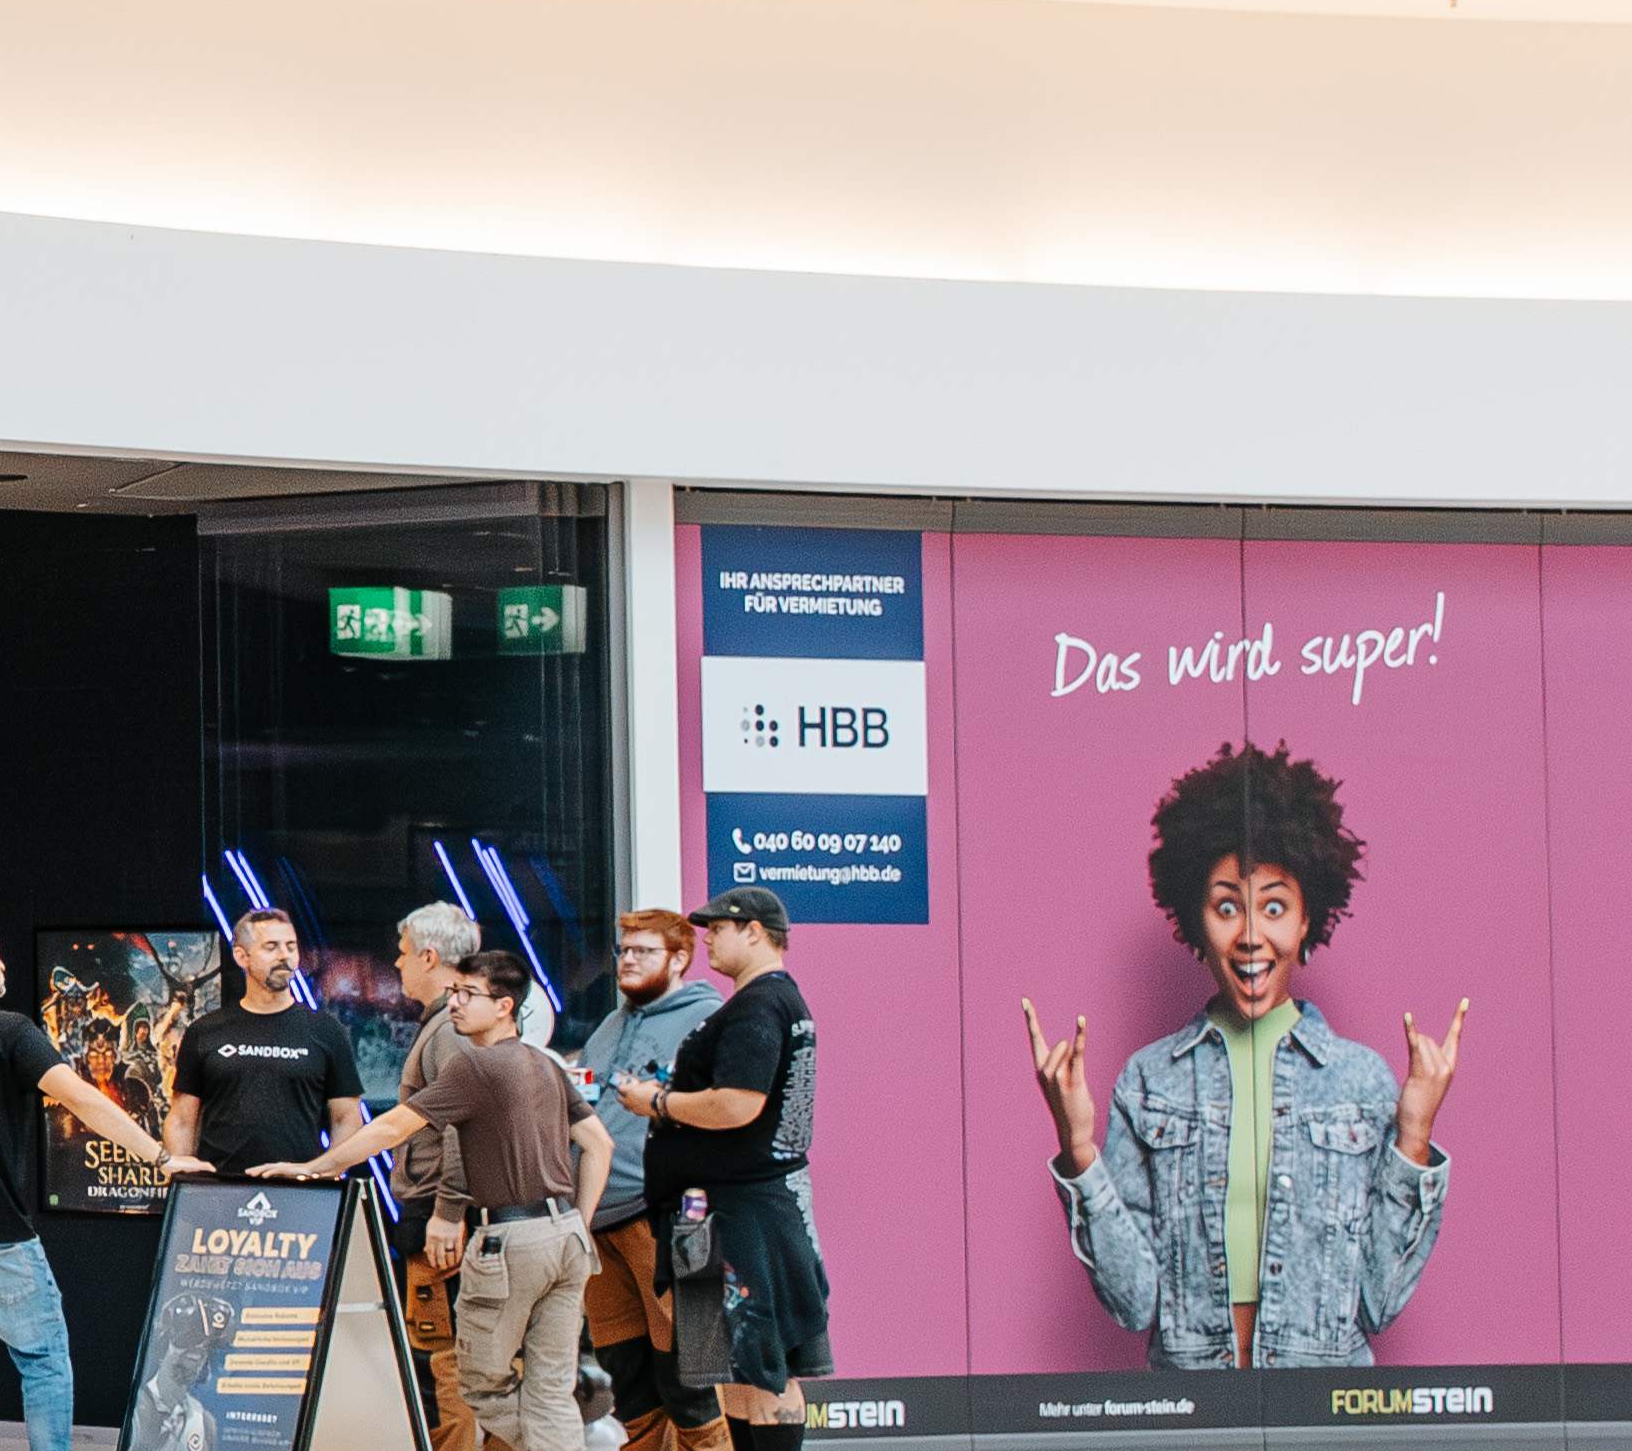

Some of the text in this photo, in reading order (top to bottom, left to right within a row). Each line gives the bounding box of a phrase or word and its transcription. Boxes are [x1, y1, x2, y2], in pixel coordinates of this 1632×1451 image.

[720, 572, 905, 594] IHR ANSPRECHPARTNER
[744, 592, 883, 616] FÜR VERMIETUNG
[1051, 592, 1445, 706] Das wird super!
[798, 706, 889, 748] HBB
[754, 830, 902, 855] 040 60 09 07 140
[759, 863, 902, 886] vermietung@hbb.de
[191, 1227, 318, 1260] LOYALTY
